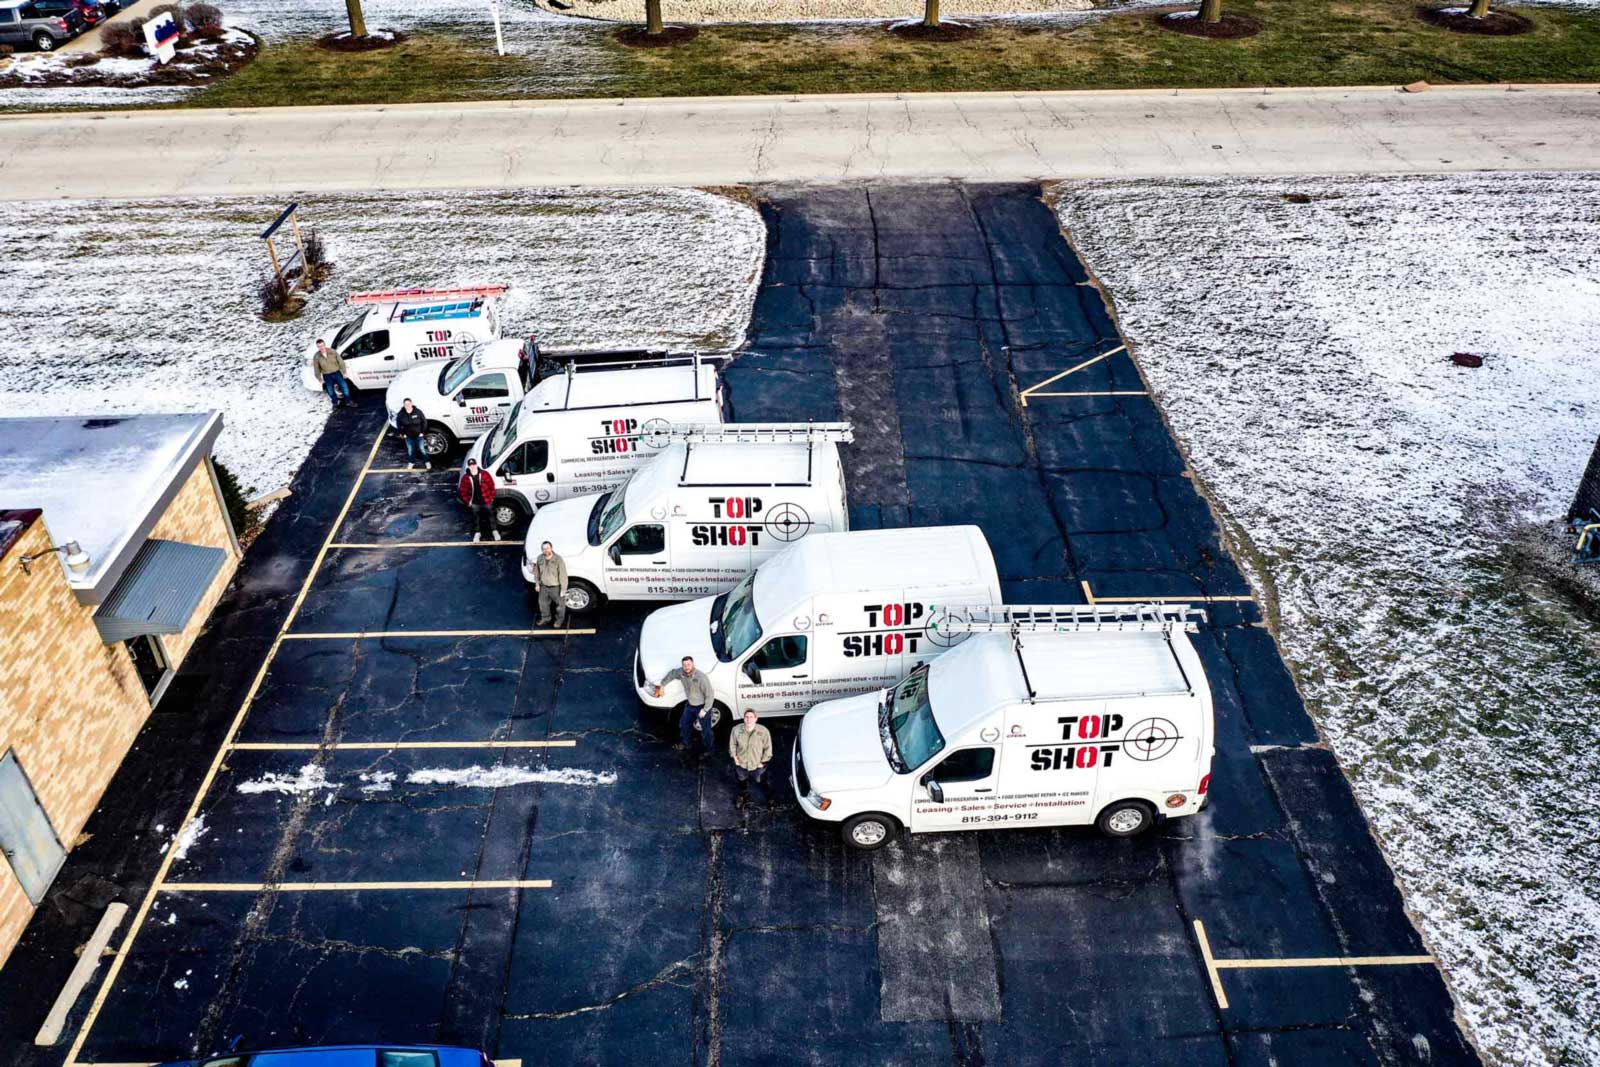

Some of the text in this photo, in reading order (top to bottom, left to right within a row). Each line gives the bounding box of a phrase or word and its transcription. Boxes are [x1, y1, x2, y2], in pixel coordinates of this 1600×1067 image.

[426, 330, 452, 342] TOP
[420, 346, 454, 358] SHOT
[470, 406, 488, 414] TOP
[465, 415, 489, 423] SHOT
[601, 418, 637, 435] TOP
[590, 437, 638, 454] SHOT
[574, 470, 602, 478] Leasing
[607, 468, 625, 476] Sales
[573, 483, 621, 493] 815-394-9
[708, 497, 762, 518] TOP
[691, 525, 763, 546] SHOT
[647, 586, 709, 594] 815-394-9112
[863, 602, 923, 627] TOP
[843, 632, 923, 657] SHOT
[741, 691, 775, 699] Leasing
[781, 689, 804, 697] Sales
[811, 687, 842, 696] Service
[1057, 714, 1124, 740] TOP
[1030, 745, 1120, 771] SHOT
[916, 799, 1086, 814] Leasing Sales Service Installation
[961, 812, 1039, 823] 815-394-9112
